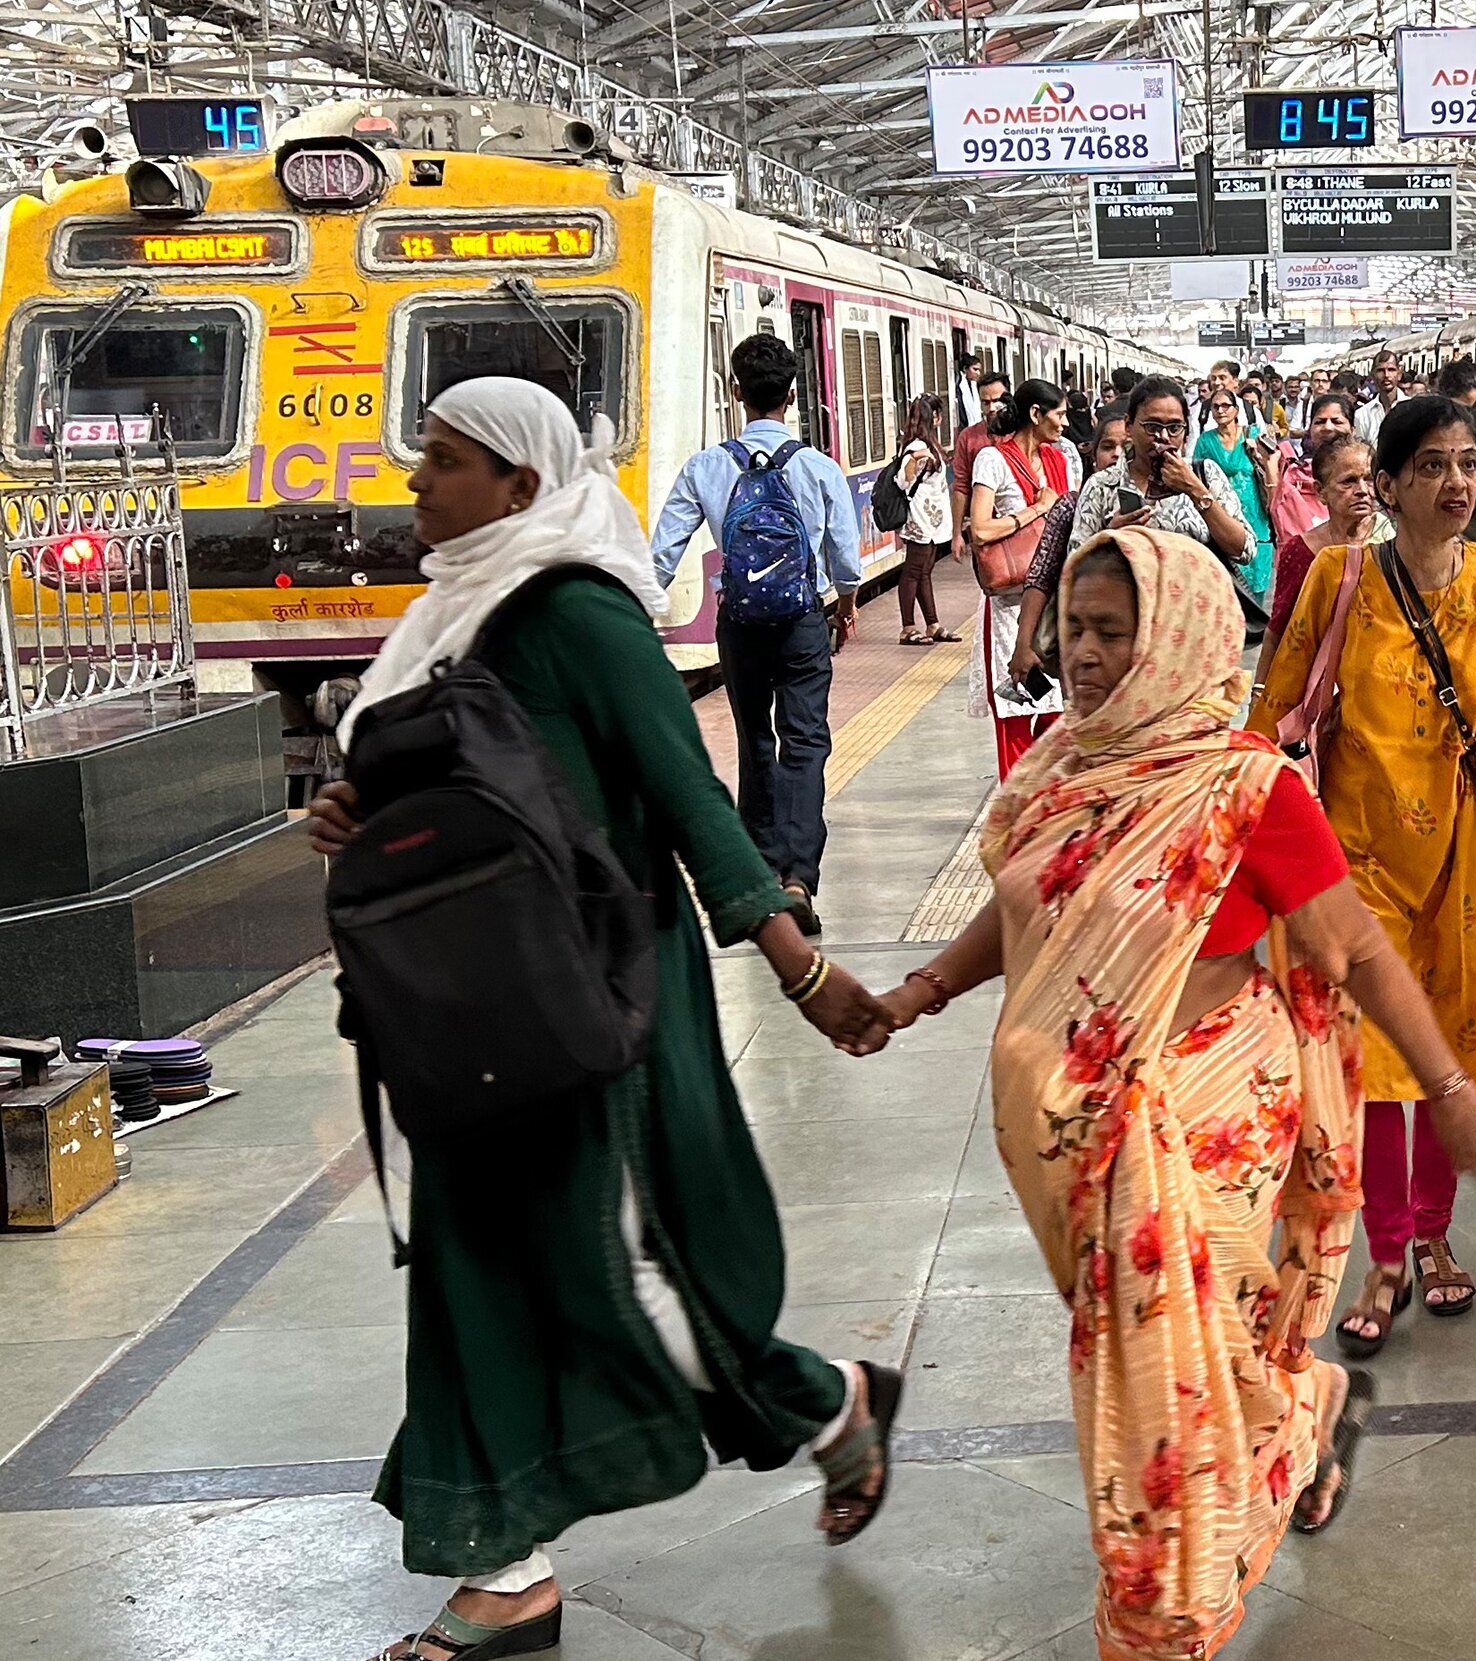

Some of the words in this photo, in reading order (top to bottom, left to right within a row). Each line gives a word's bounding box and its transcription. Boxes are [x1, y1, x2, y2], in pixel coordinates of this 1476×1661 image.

[618, 108, 639, 131] 4
[1090, 103, 1146, 121] OOH
[1003, 127, 1038, 136] Contact
[1040, 127, 1054, 135] For
[1057, 125, 1106, 135] Advertising
[963, 137, 1051, 163] 99203
[1060, 134, 1149, 160] 74688
[1099, 183, 1122, 196] 8:41
[1135, 182, 1168, 195] KURLA
[1219, 180, 1230, 192] 12
[1232, 179, 1260, 192] Slow
[1285, 177, 1313, 189] 8:48
[1322, 176, 1365, 189] THANE
[1406, 175, 1420, 188] 12
[1422, 175, 1451, 188] Fast
[1108, 205, 1121, 217] All
[1123, 204, 1174, 217] Stations
[1283, 198, 1340, 211] BYCULLA
[1341, 198, 1384, 211] DADAR
[1396, 198, 1440, 210] KURLA
[1283, 211, 1340, 225] VIKHROLI
[1341, 211, 1392, 225] MULUND
[1287, 276, 1321, 287] 99203
[1325, 275, 1359, 285] 74688
[278, 393, 373, 418] 6008
[247, 441, 382, 502] ICF
